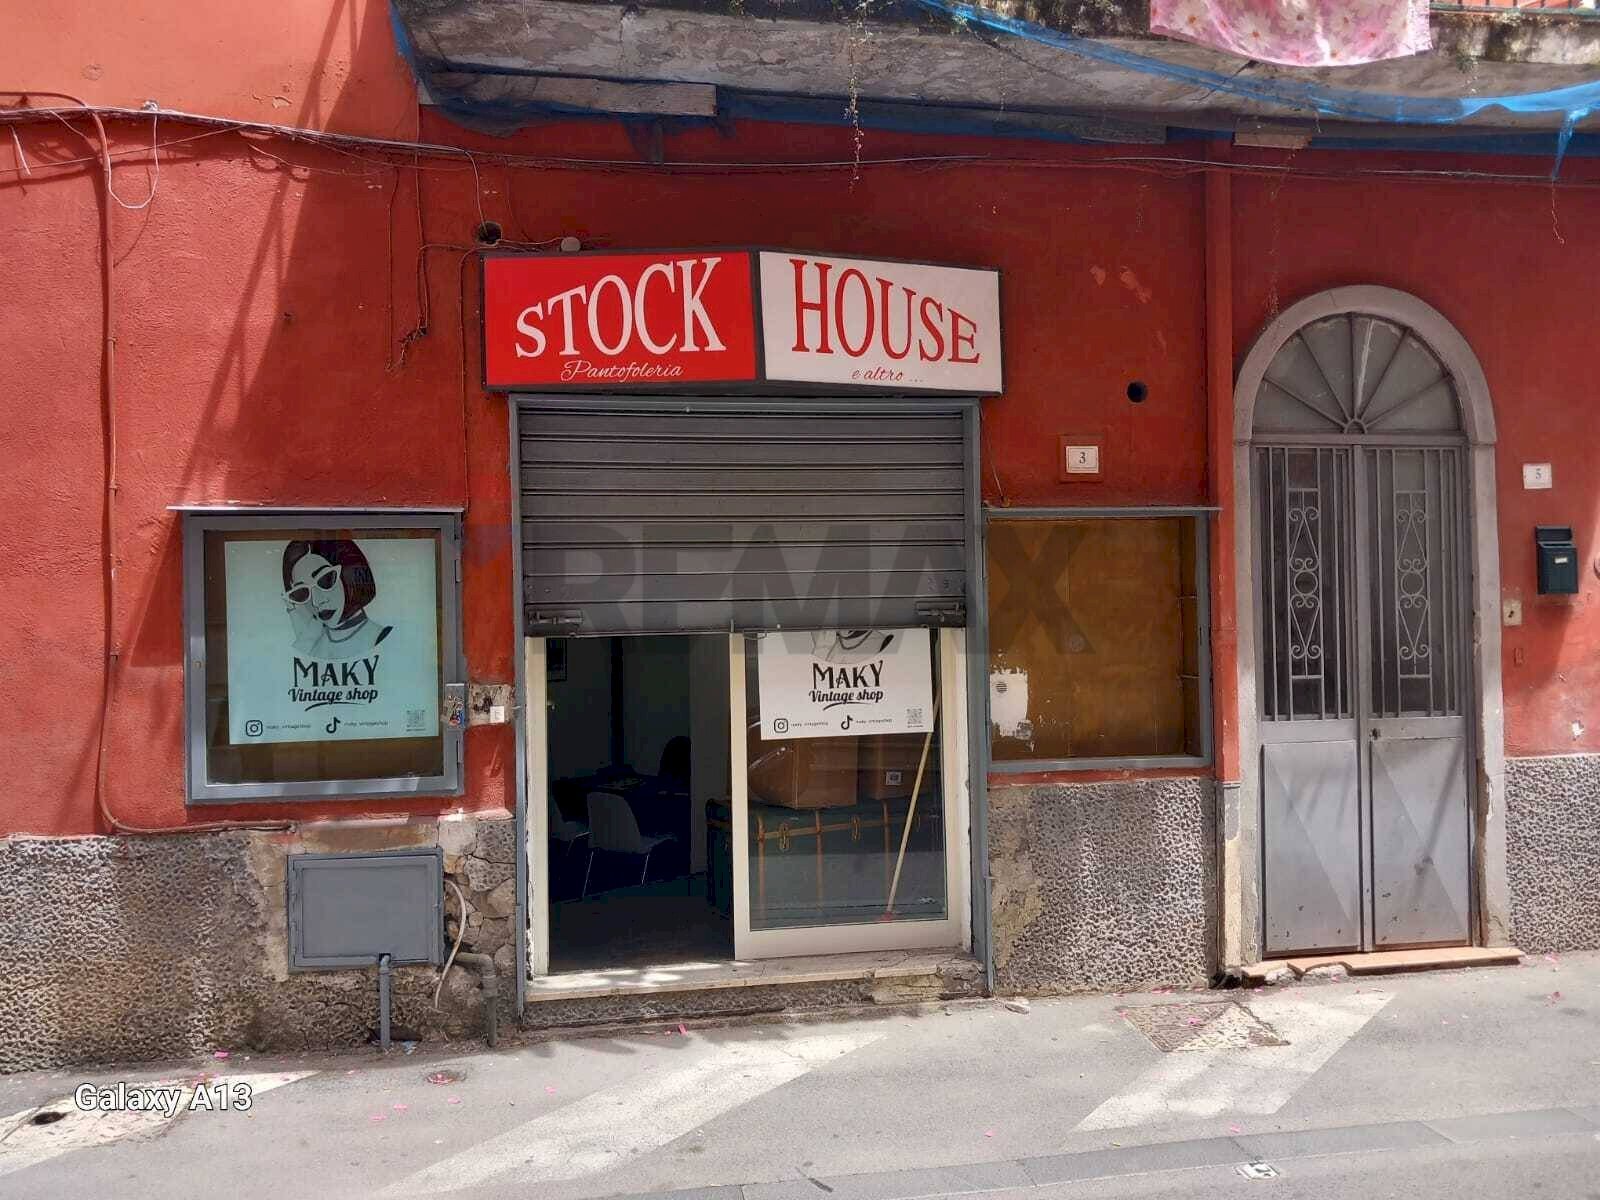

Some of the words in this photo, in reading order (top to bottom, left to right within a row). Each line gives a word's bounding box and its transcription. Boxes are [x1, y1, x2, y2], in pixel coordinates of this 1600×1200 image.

[514, 257, 727, 358] STOCK
[789, 258, 981, 364] HOUSE
[560, 359, 684, 383] Pantofoleria
[851, 367, 862, 380] e
[863, 366, 904, 381] altro
[1079, 451, 1087, 465] 3
[293, 655, 380, 687] MAKY
[812, 660, 884, 690] MAKY
[287, 688, 343, 705] Vintage
[345, 687, 379, 703] shop
[808, 690, 855, 704] Vintage
[855, 689, 884, 703] shop
